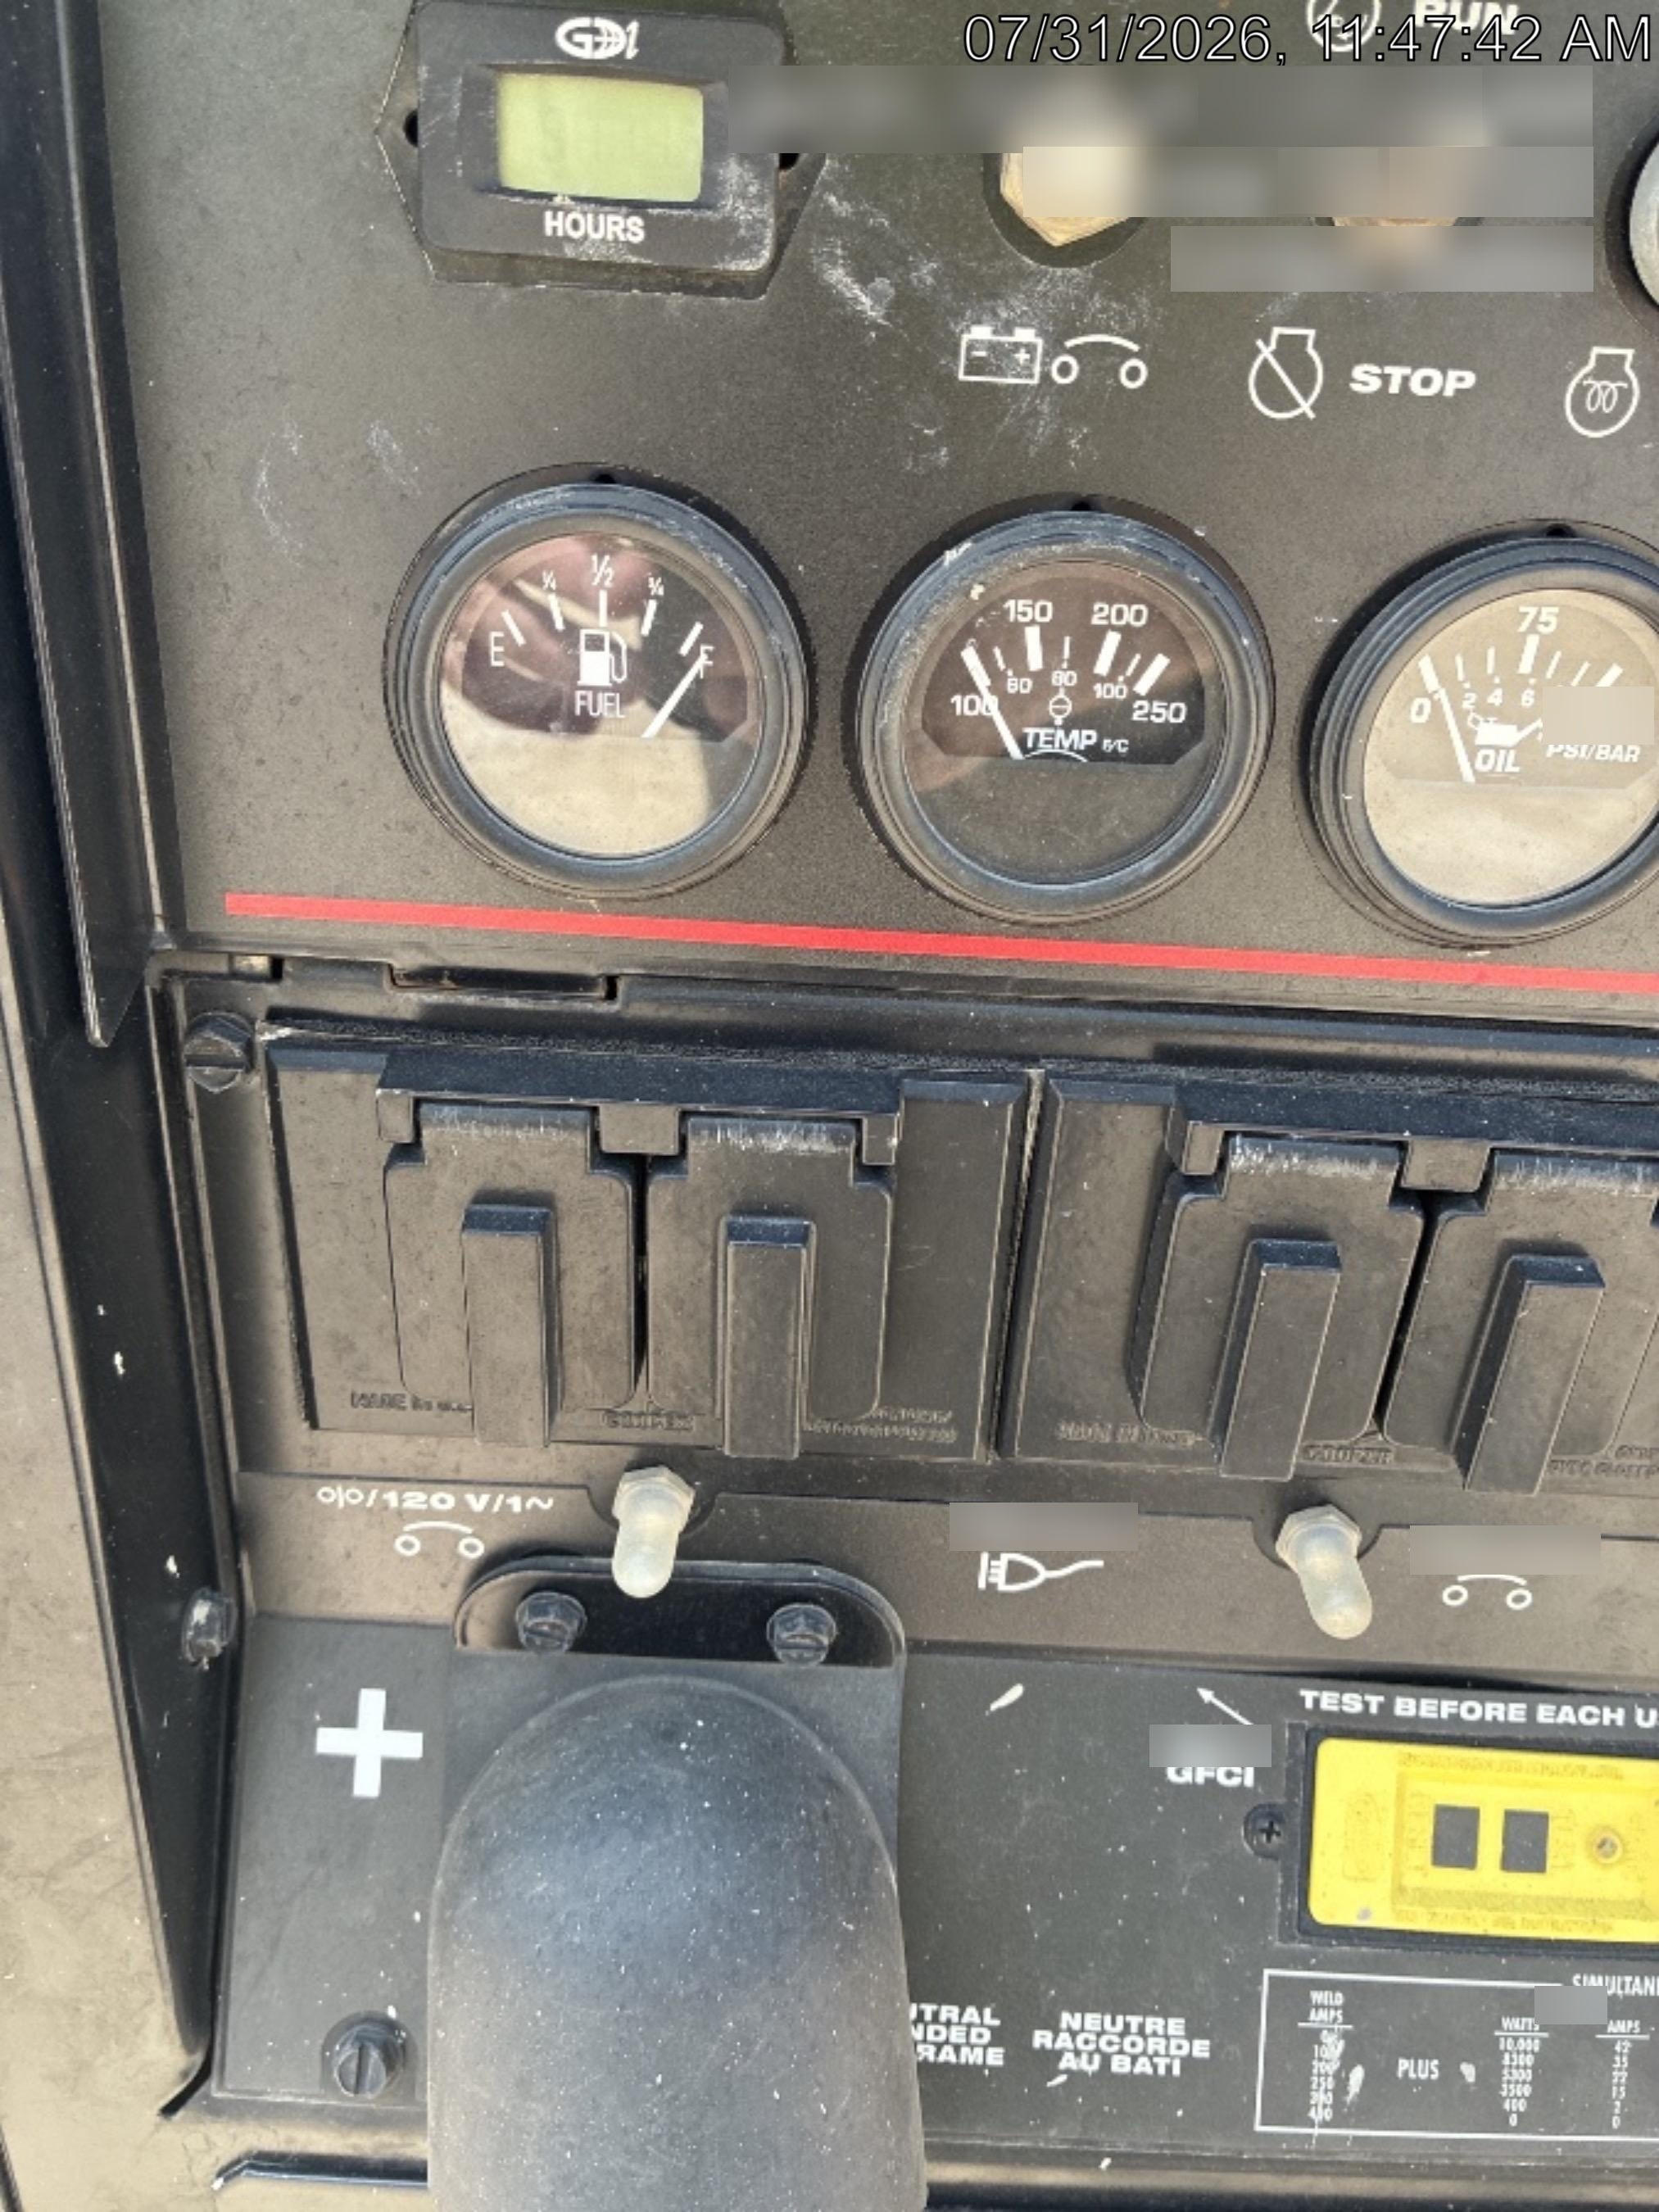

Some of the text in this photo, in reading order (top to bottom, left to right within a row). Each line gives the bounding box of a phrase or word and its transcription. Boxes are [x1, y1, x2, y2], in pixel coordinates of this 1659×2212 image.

[1415, 0, 1520, 35] RUN
[544, 211, 646, 243] HOURS
[1349, 363, 1476, 397] STOP
[1003, 600, 1054, 623] 150
[1090, 604, 1149, 627] 200
[1517, 606, 1560, 634] 75
[489, 631, 505, 667] E
[700, 645, 714, 679] F
[1093, 682, 1128, 700] 100
[1462, 692, 1476, 708] 2
[1487, 688, 1503, 706] 4
[574, 691, 627, 719] FUEL
[950, 694, 999, 717] 100
[1131, 700, 1187, 723] 250
[1410, 697, 1432, 723] 0
[1023, 727, 1097, 750] TEMP
[1475, 748, 1521, 773] OIL
[1545, 744, 1641, 763] PSI/BAR
[1299, 1688, 1659, 1729] TEST BEFORE EACH U
[1166, 1766, 1255, 1788] GFCI
[1572, 1973, 1659, 1997] SIMULTAN
[1309, 1989, 1345, 2006] WELD
[1060, 2010, 1186, 2037] NEUTRE
[1308, 2007, 1344, 2024] AMPS
[1607, 2019, 1641, 2033] AMPS
[1031, 2028, 1211, 2059] RACCORDE
[1058, 2051, 1182, 2077] AU BATI
[1396, 2058, 1440, 2081] PLUS
[1611, 2086, 1626, 2100] 15
[1508, 2113, 1518, 2127] 0
[1611, 2115, 1621, 2129] 0
